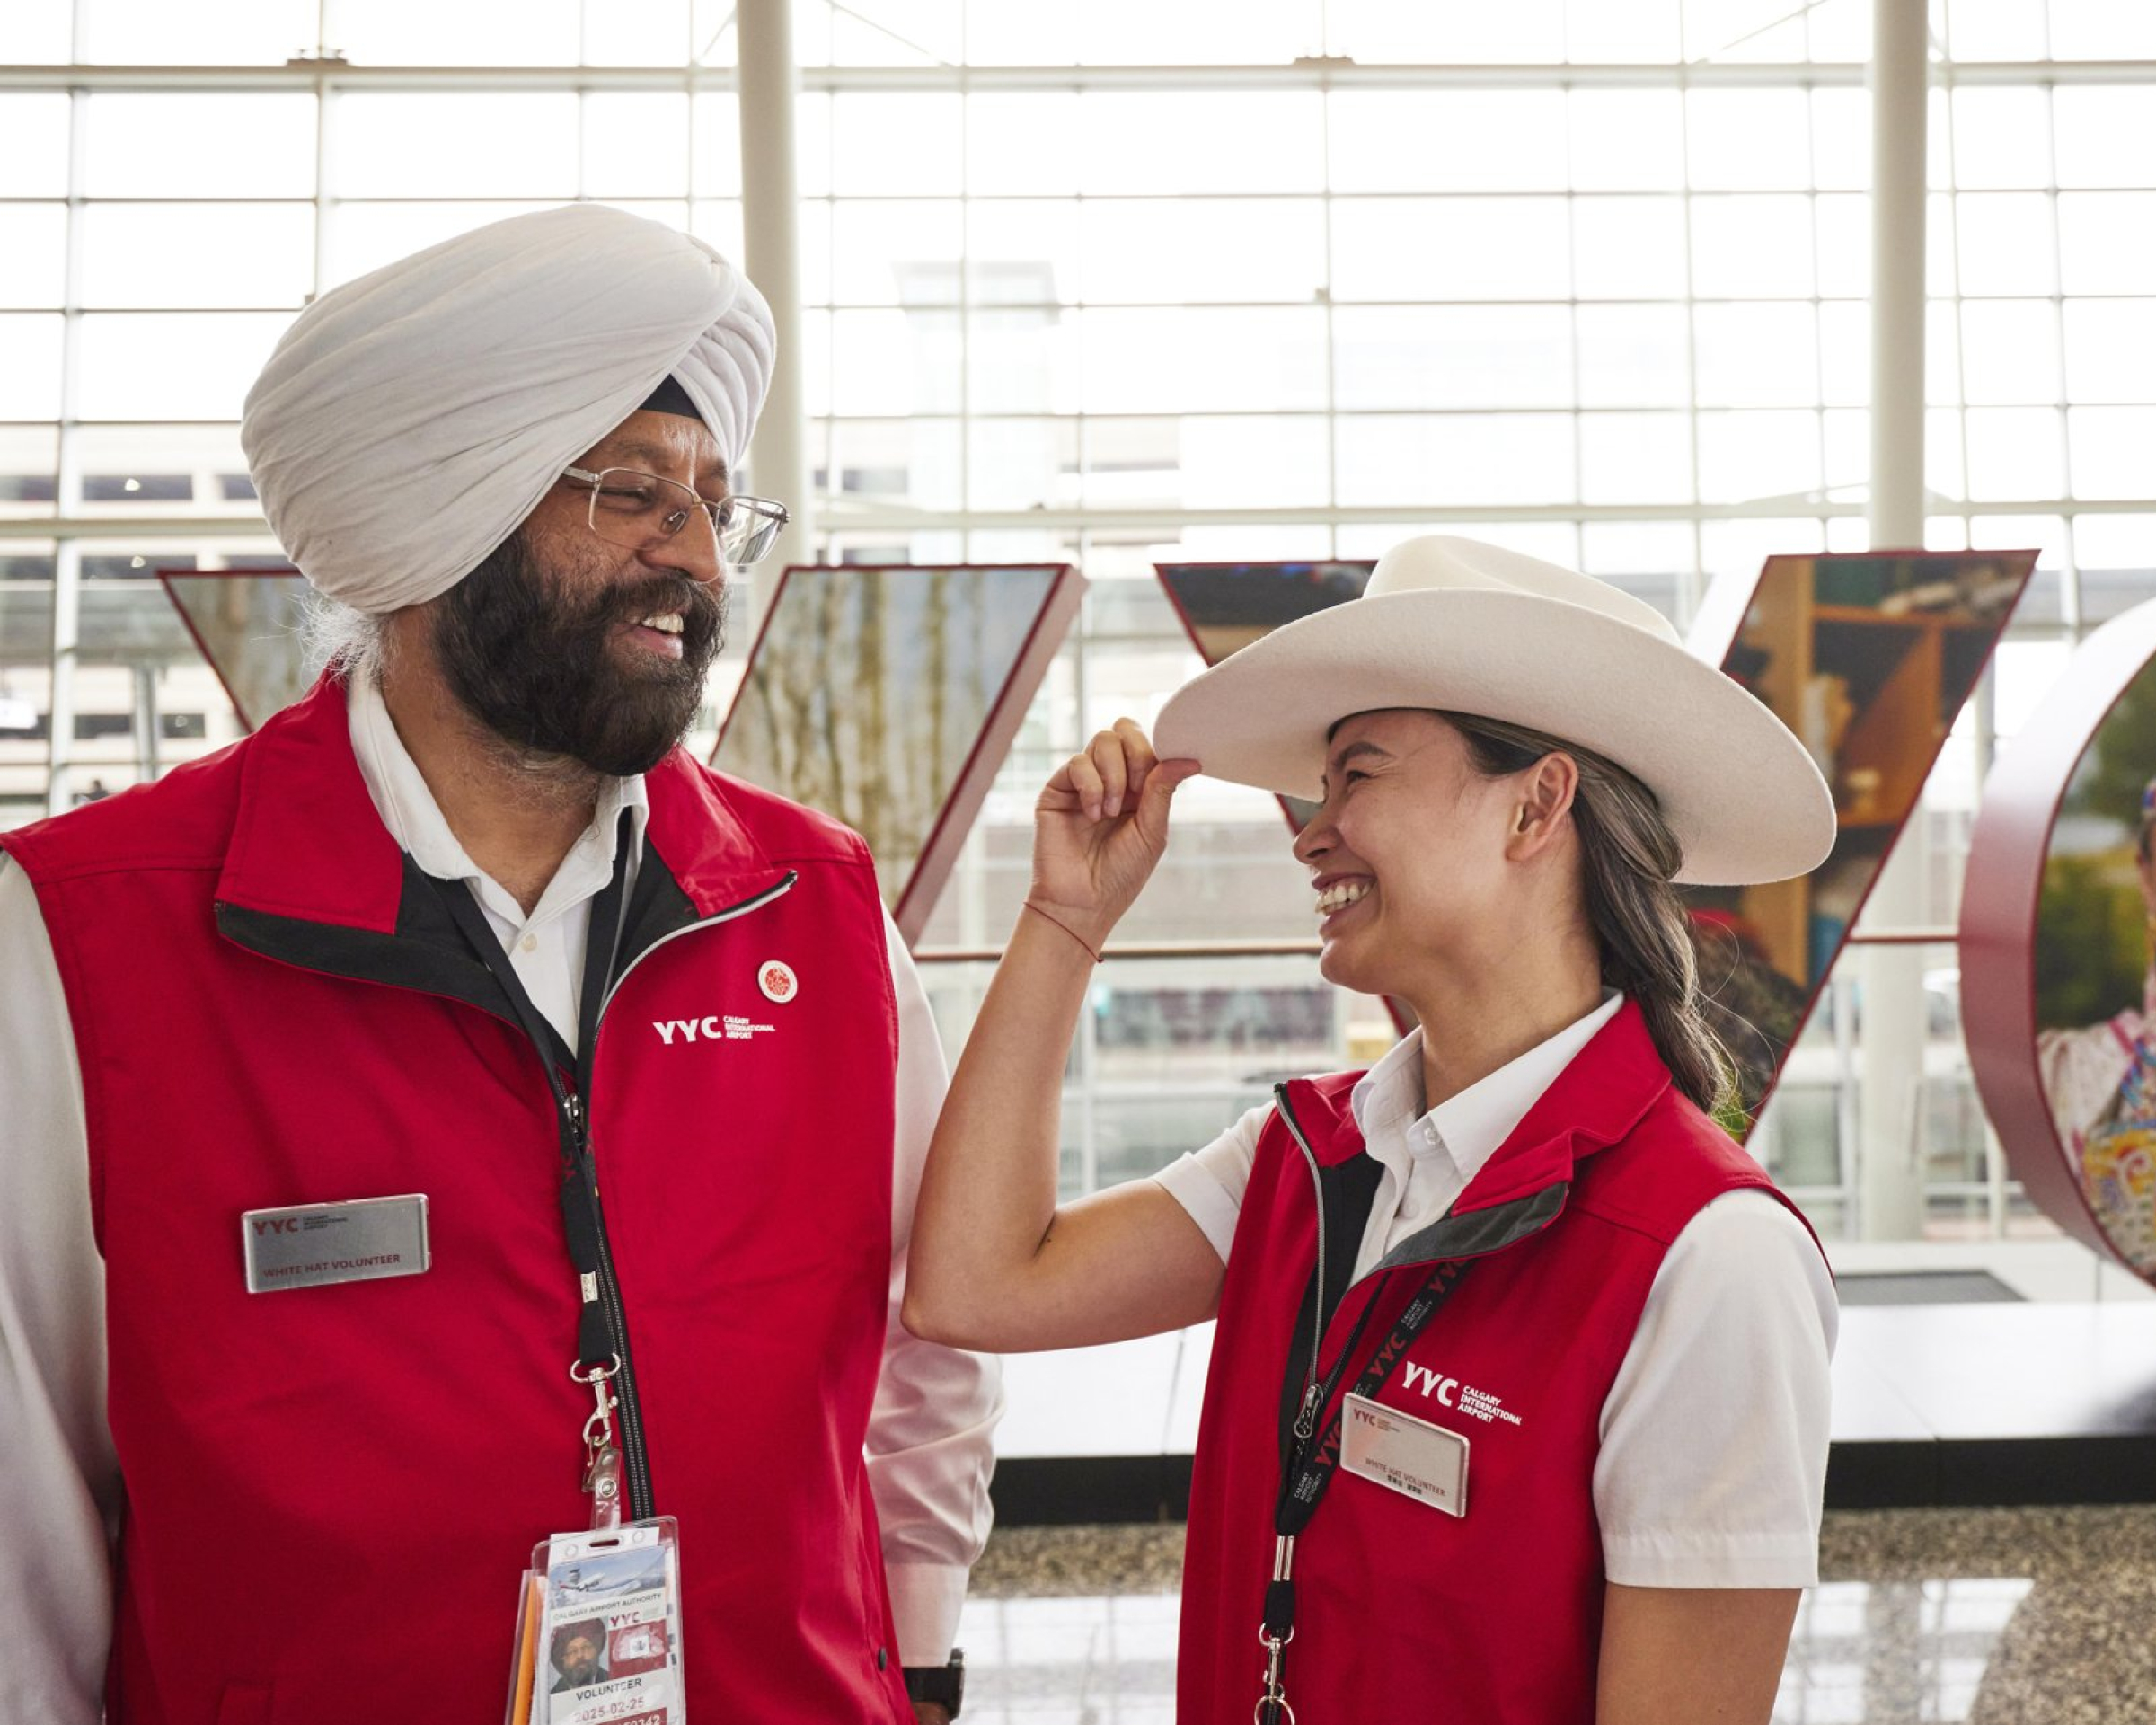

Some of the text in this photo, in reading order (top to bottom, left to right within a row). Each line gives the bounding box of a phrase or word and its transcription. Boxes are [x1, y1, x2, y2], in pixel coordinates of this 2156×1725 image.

[653, 1016, 722, 1045] YYC
[252, 1217, 299, 1236] YYC
[263, 1254, 401, 1278] WHITE HAT VOLUNTEER
[1367, 1332, 1406, 1376] YYC
[1402, 1360, 1459, 1407] YYC
[1462, 1385, 1502, 1407] CALGARY
[1353, 1408, 1376, 1427] YYC
[1457, 1403, 1496, 1423] AIRPORT
[589, 1601, 620, 1613] AIRPORT
[623, 1593, 661, 1606] AUTHORITY
[576, 1677, 641, 1701] VOLUNTEER
[575, 1696, 645, 1723] 2025-02-25
